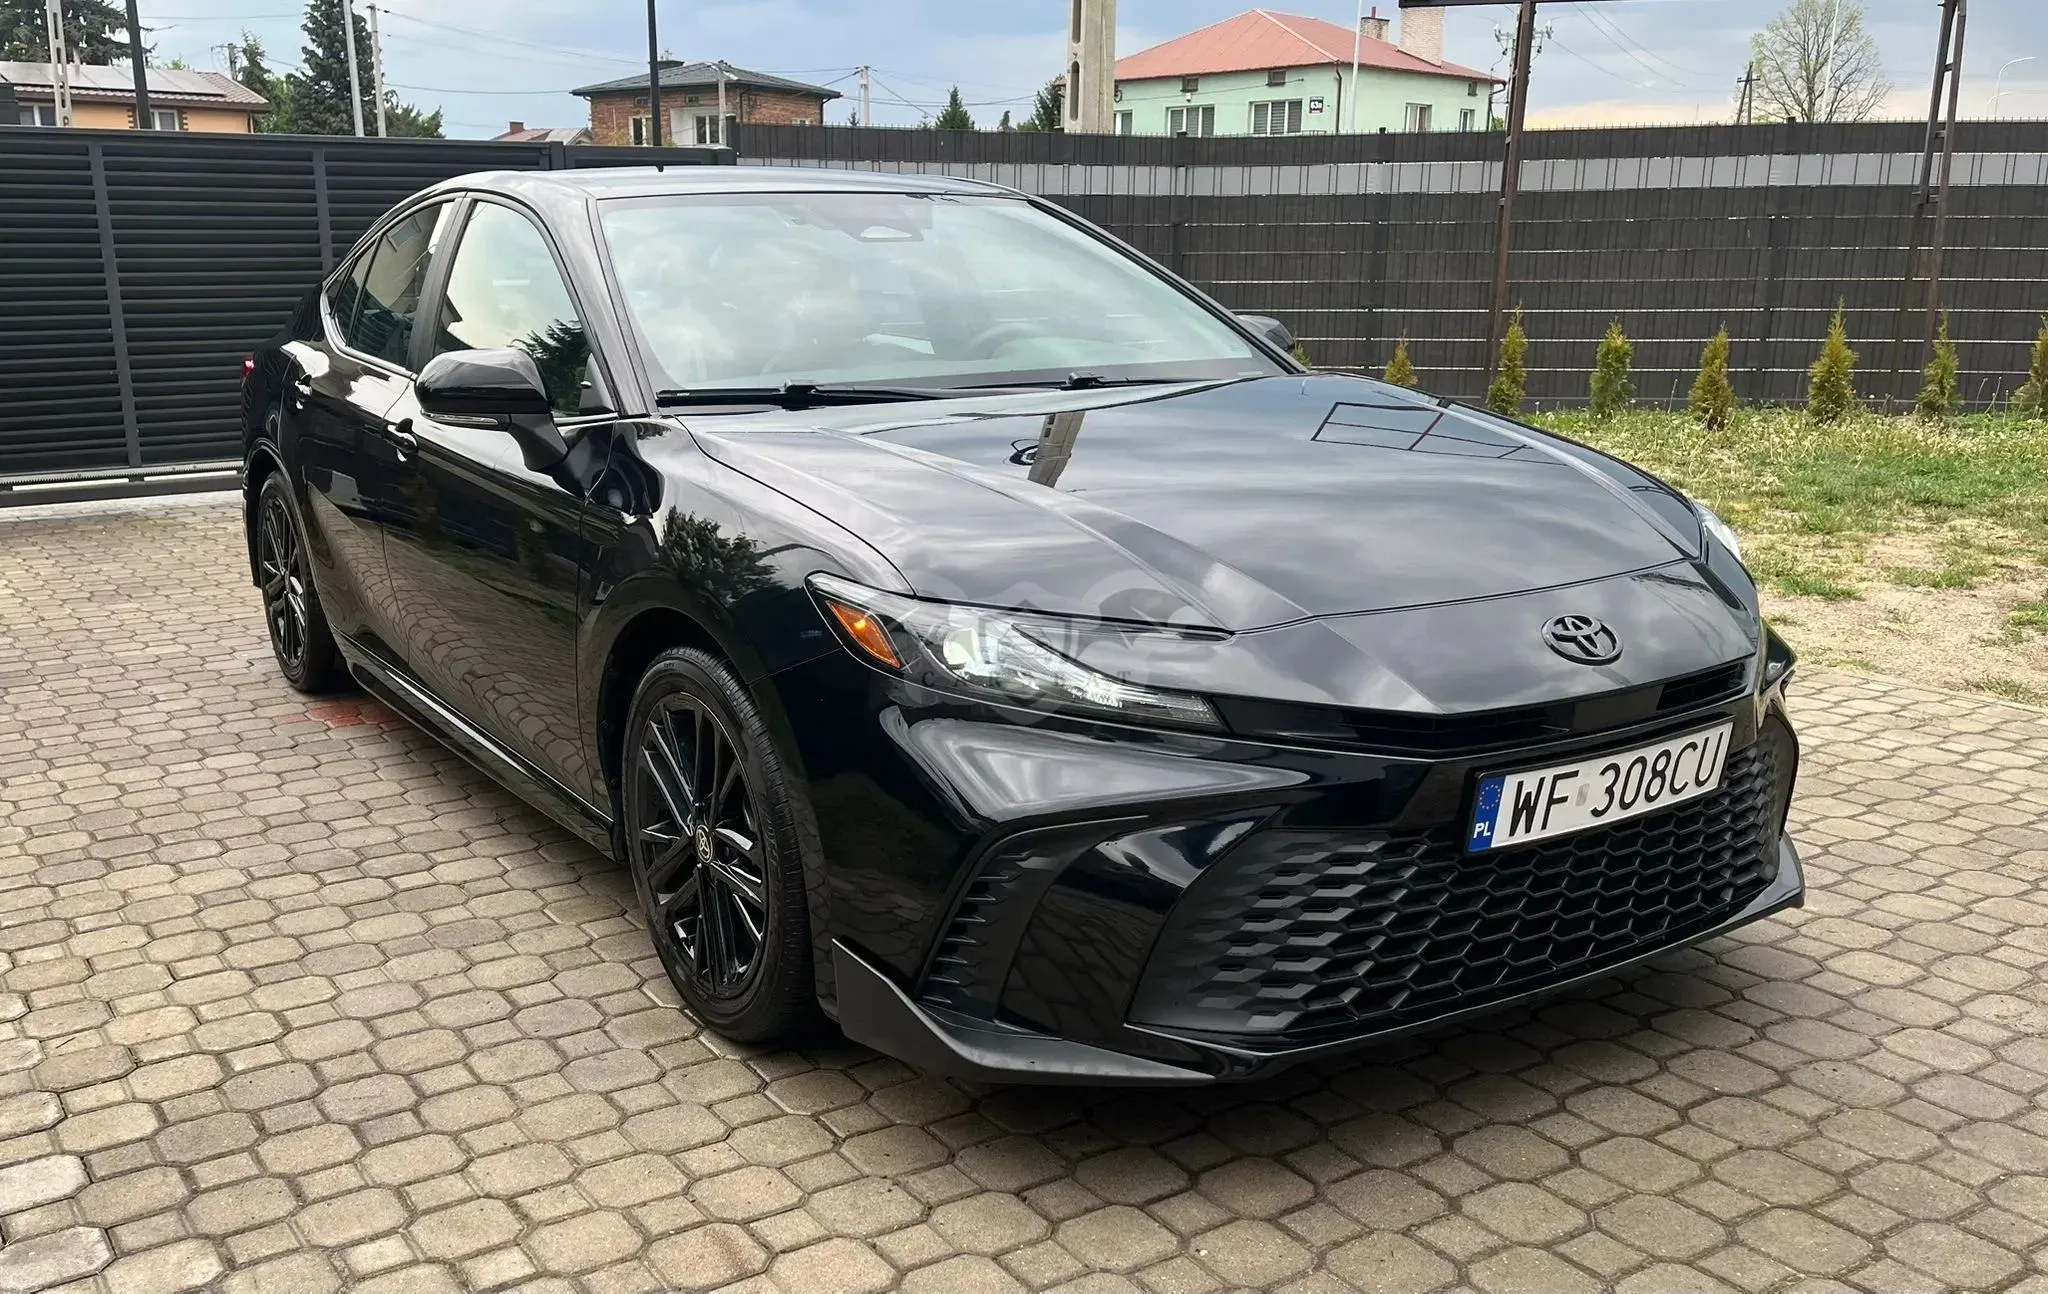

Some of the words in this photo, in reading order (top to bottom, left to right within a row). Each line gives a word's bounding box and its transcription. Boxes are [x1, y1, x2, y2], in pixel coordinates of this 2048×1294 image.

[1508, 769, 1579, 837] WF
[1590, 731, 1724, 818] 308CU
[1473, 822, 1491, 839] PL
